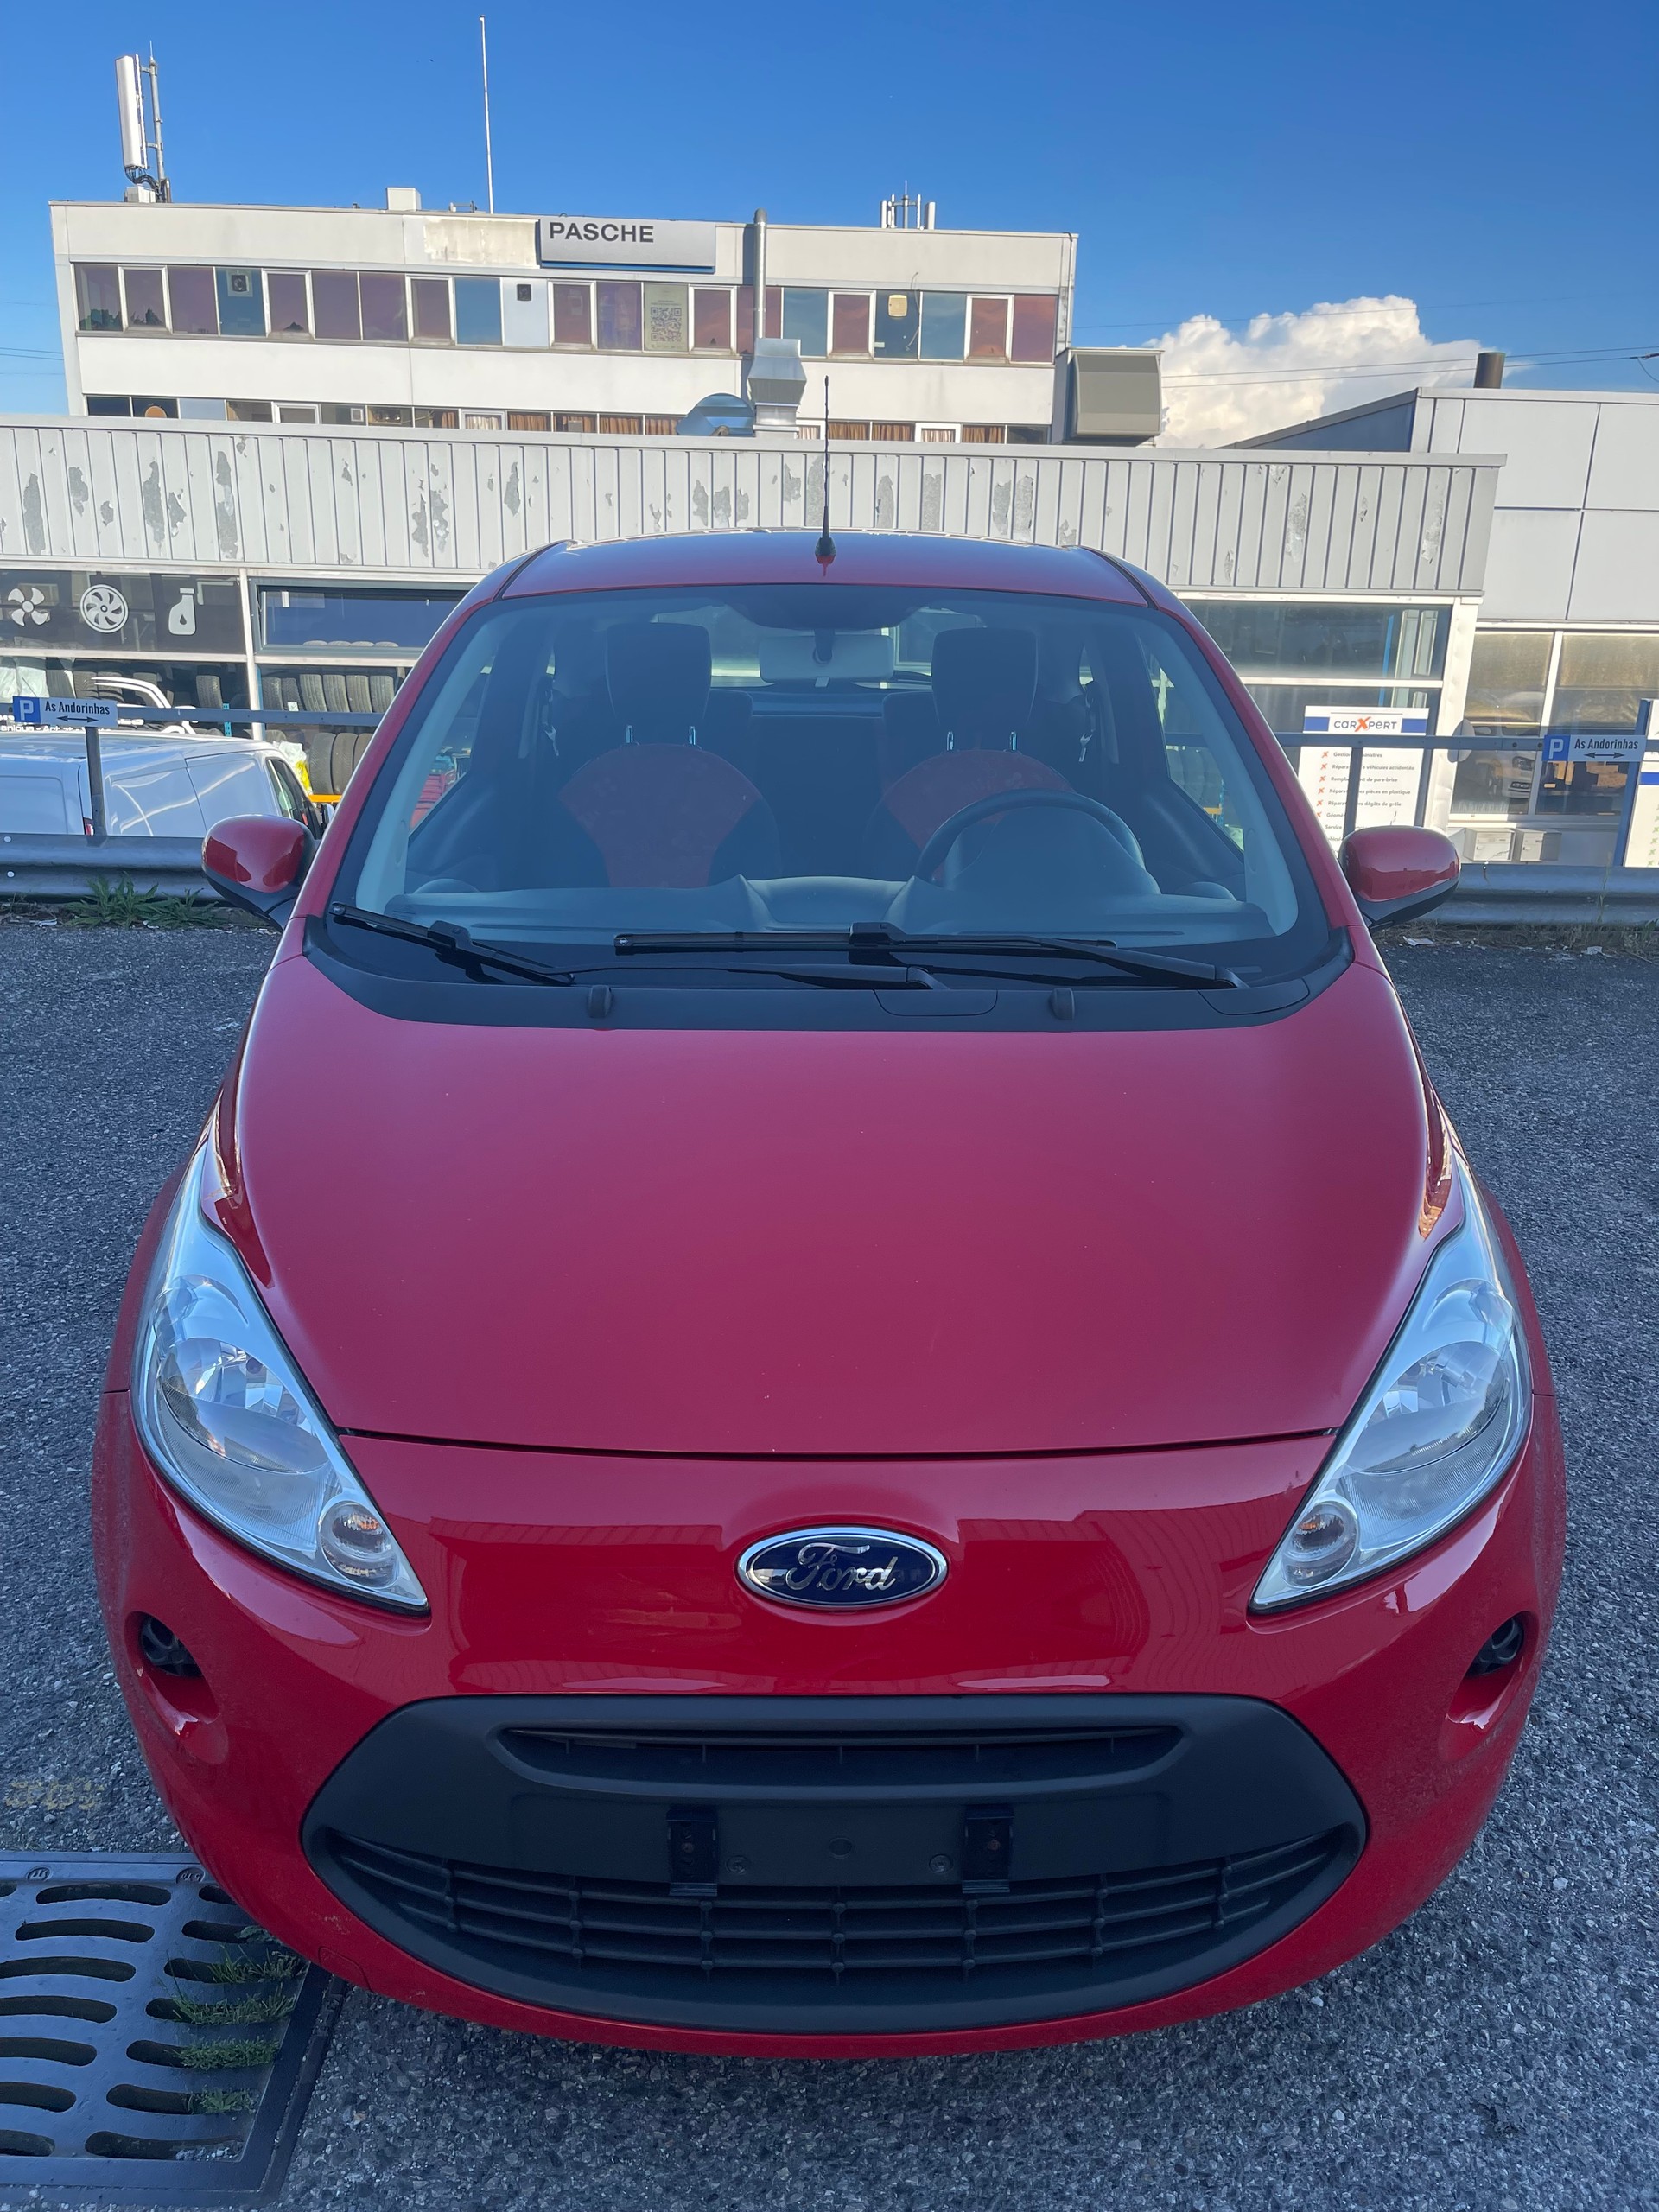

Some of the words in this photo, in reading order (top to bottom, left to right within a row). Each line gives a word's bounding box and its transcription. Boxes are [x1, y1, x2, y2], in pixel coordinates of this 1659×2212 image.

[550, 222, 654, 243] PASCHE
[19, 699, 34, 721] P
[45, 701, 56, 712] As
[59, 702, 111, 715] Andorinhas
[1549, 738, 1564, 760] P
[1574, 739, 1586, 749] As
[1588, 739, 1638, 749] Andorinhas
[785, 1542, 899, 1591] Ford
